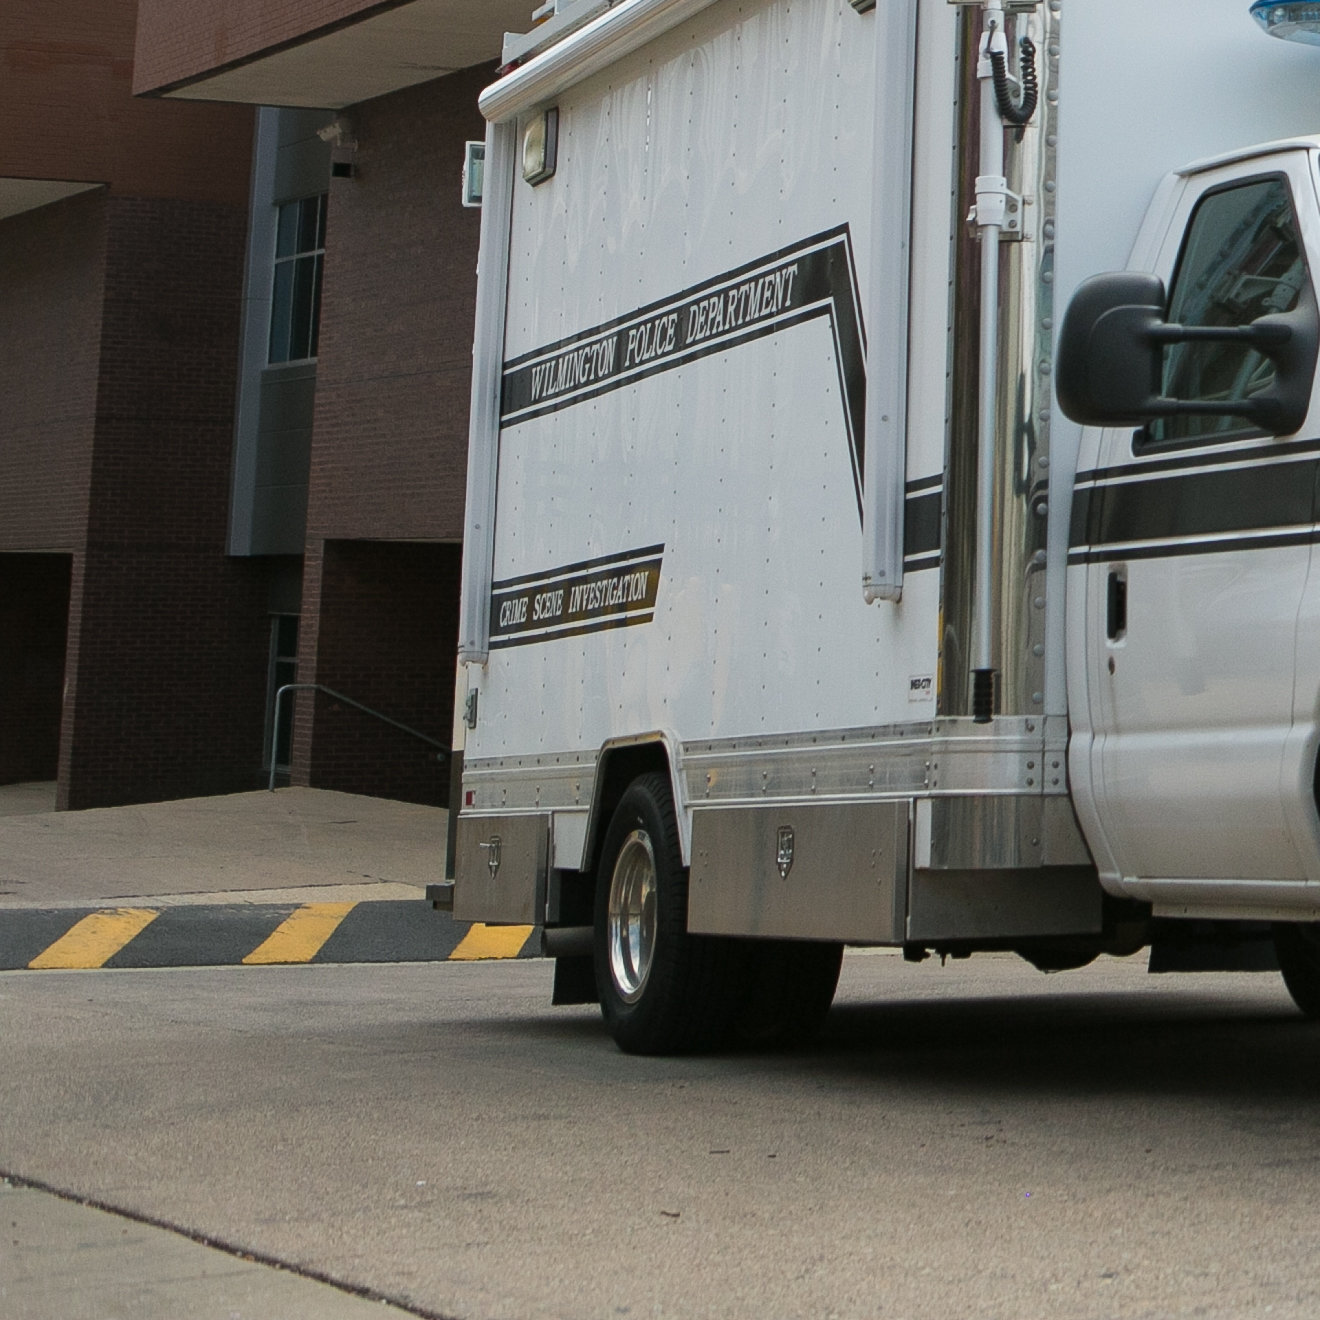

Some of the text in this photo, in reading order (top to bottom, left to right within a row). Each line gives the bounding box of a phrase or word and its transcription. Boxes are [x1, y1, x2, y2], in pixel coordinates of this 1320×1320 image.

[530, 263, 799, 402] WILMINGTON POLICE DEPARTMENT
[500, 570, 650, 628] CRIME SCENE INVESTIGATION
